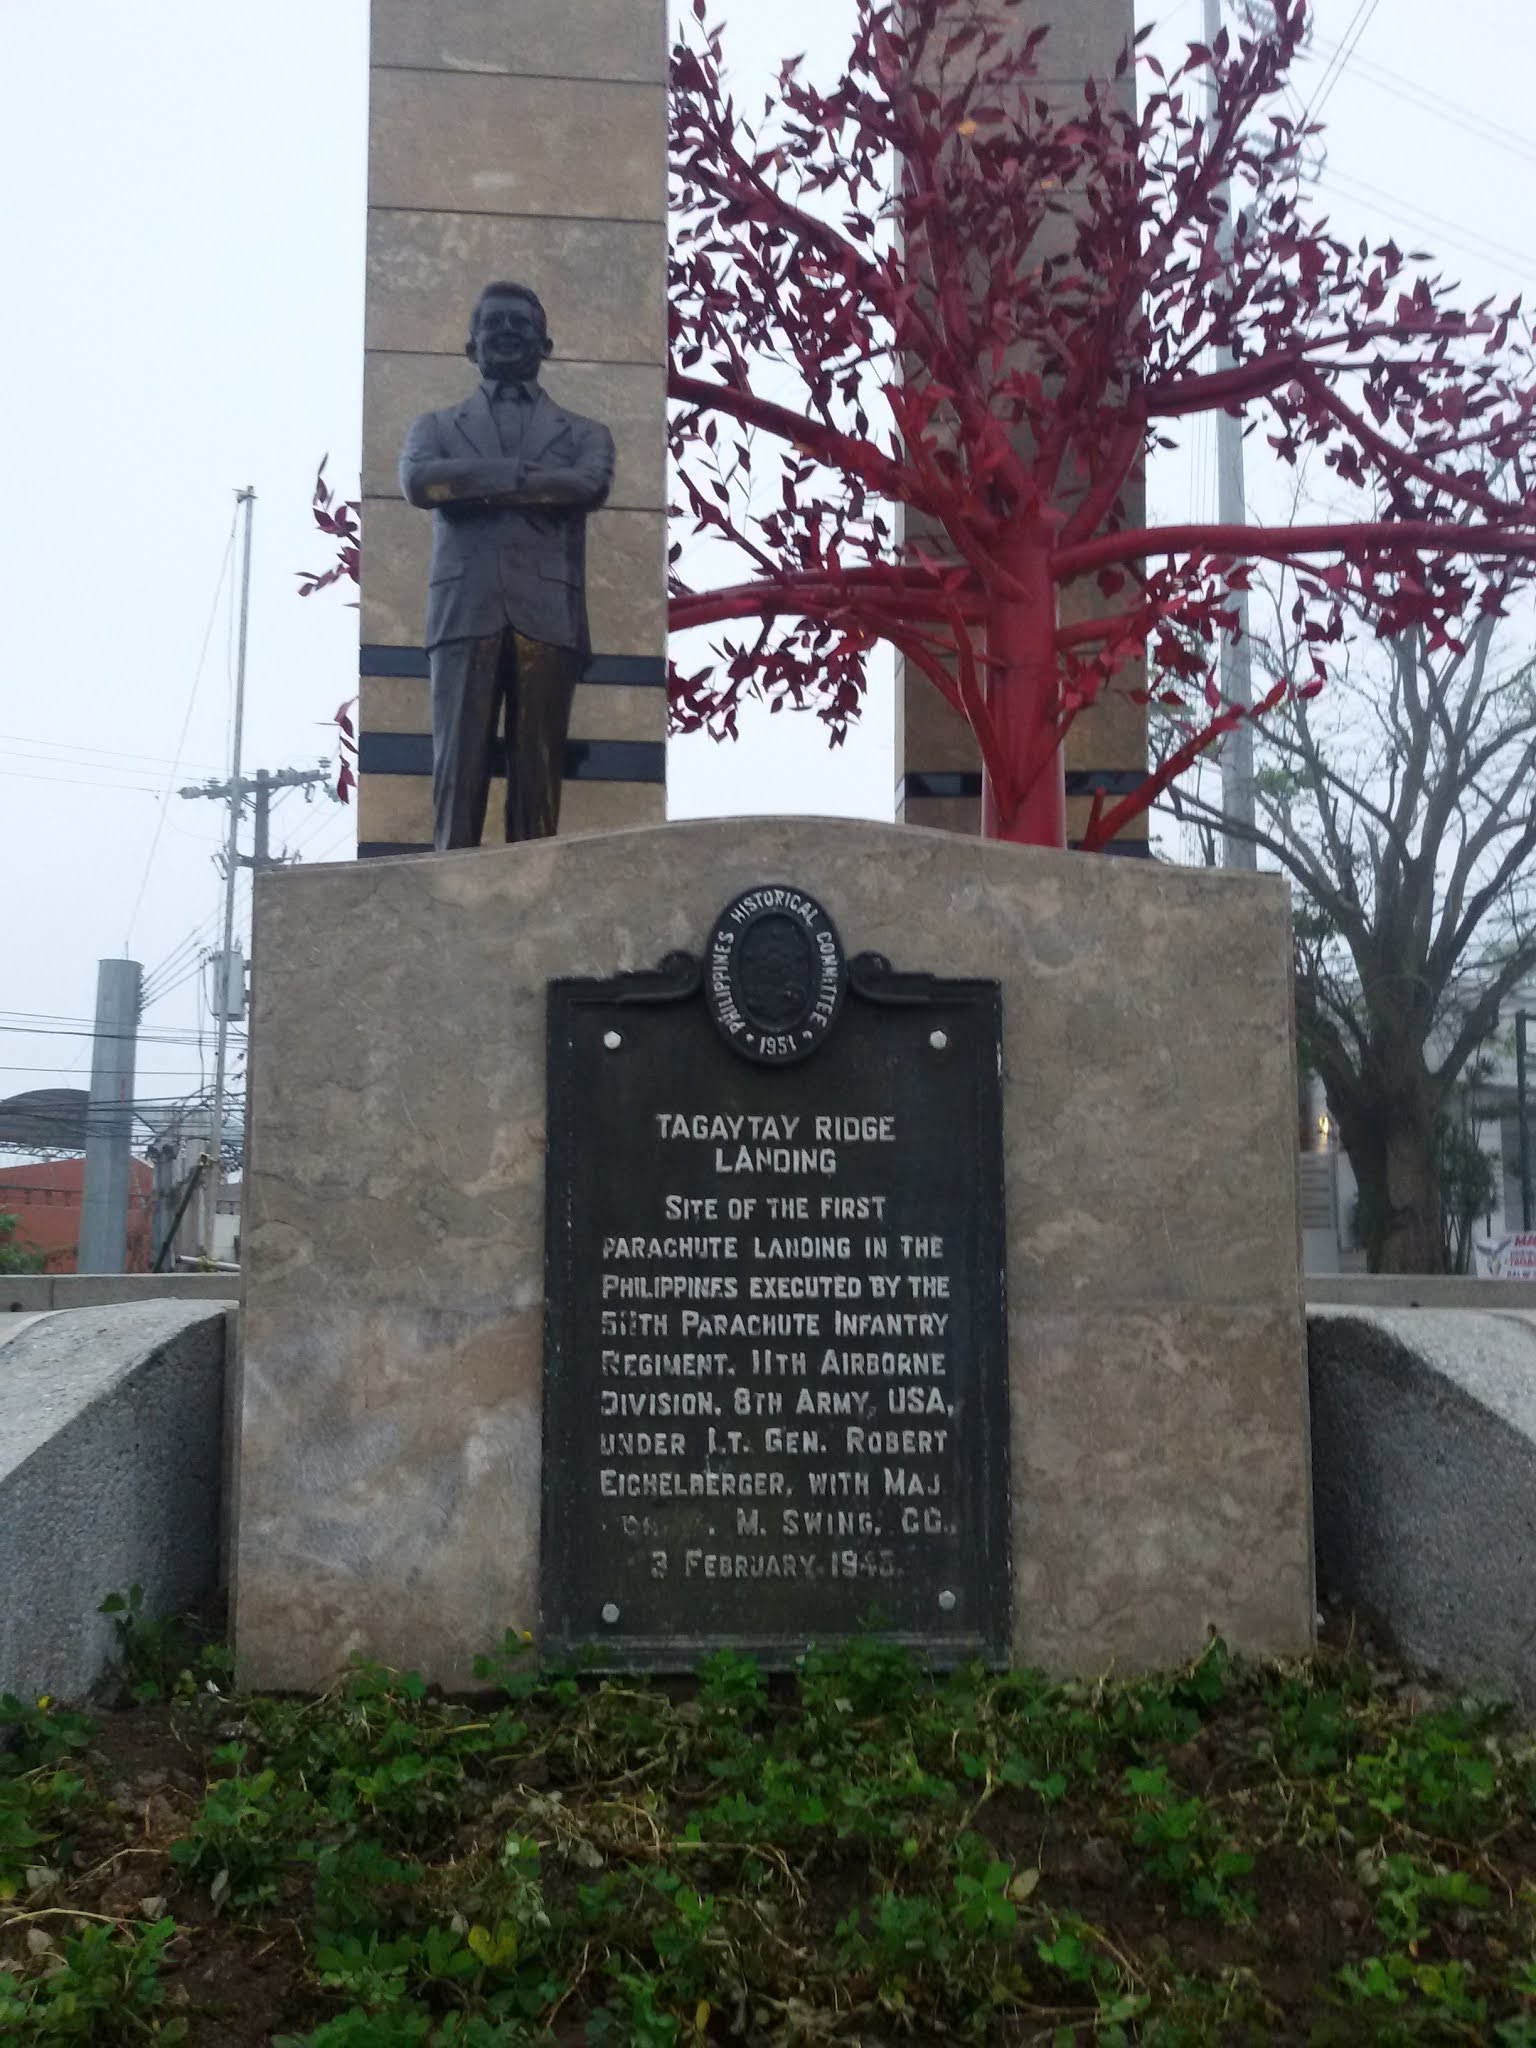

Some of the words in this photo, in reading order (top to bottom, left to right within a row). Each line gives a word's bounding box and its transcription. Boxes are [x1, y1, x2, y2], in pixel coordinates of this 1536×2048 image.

[713, 931, 746, 1034] PHILIPPINES
[730, 889, 818, 927] HISTORICAL
[810, 931, 838, 1028] COMMITTEE
[760, 1035, 797, 1055] 1951
[657, 1114, 800, 1140] TAGAYTAY
[815, 1116, 896, 1141] RIDGE
[715, 1145, 836, 1174] LANDING
[665, 1195, 718, 1220] SITE
[728, 1198, 757, 1220] OF
[767, 1198, 809, 1220] THE
[820, 1197, 887, 1220] FIRST
[603, 1236, 738, 1259] PARACHUTE
[754, 1236, 851, 1259] LANDING
[865, 1236, 887, 1259] IN
[900, 1235, 943, 1258] THE
[602, 1274, 738, 1299] PHILIPPINES
[750, 1275, 862, 1299] EXECUTED
[872, 1276, 900, 1298] BY
[908, 1276, 950, 1298] THE
[681, 1310, 820, 1338] PARACHUTE
[834, 1310, 949, 1336] INFANTRY
[752, 1349, 806, 1376] 11TH
[820, 1349, 945, 1376] AIRBORNE
[734, 1387, 782, 1416] 8TH
[600, 1432, 685, 1456] UNDER
[765, 1427, 827, 1454] GEN.
[846, 1426, 948, 1454] ROBERT
[808, 1472, 869, 1496] WITH
[736, 1507, 767, 1537] M.
